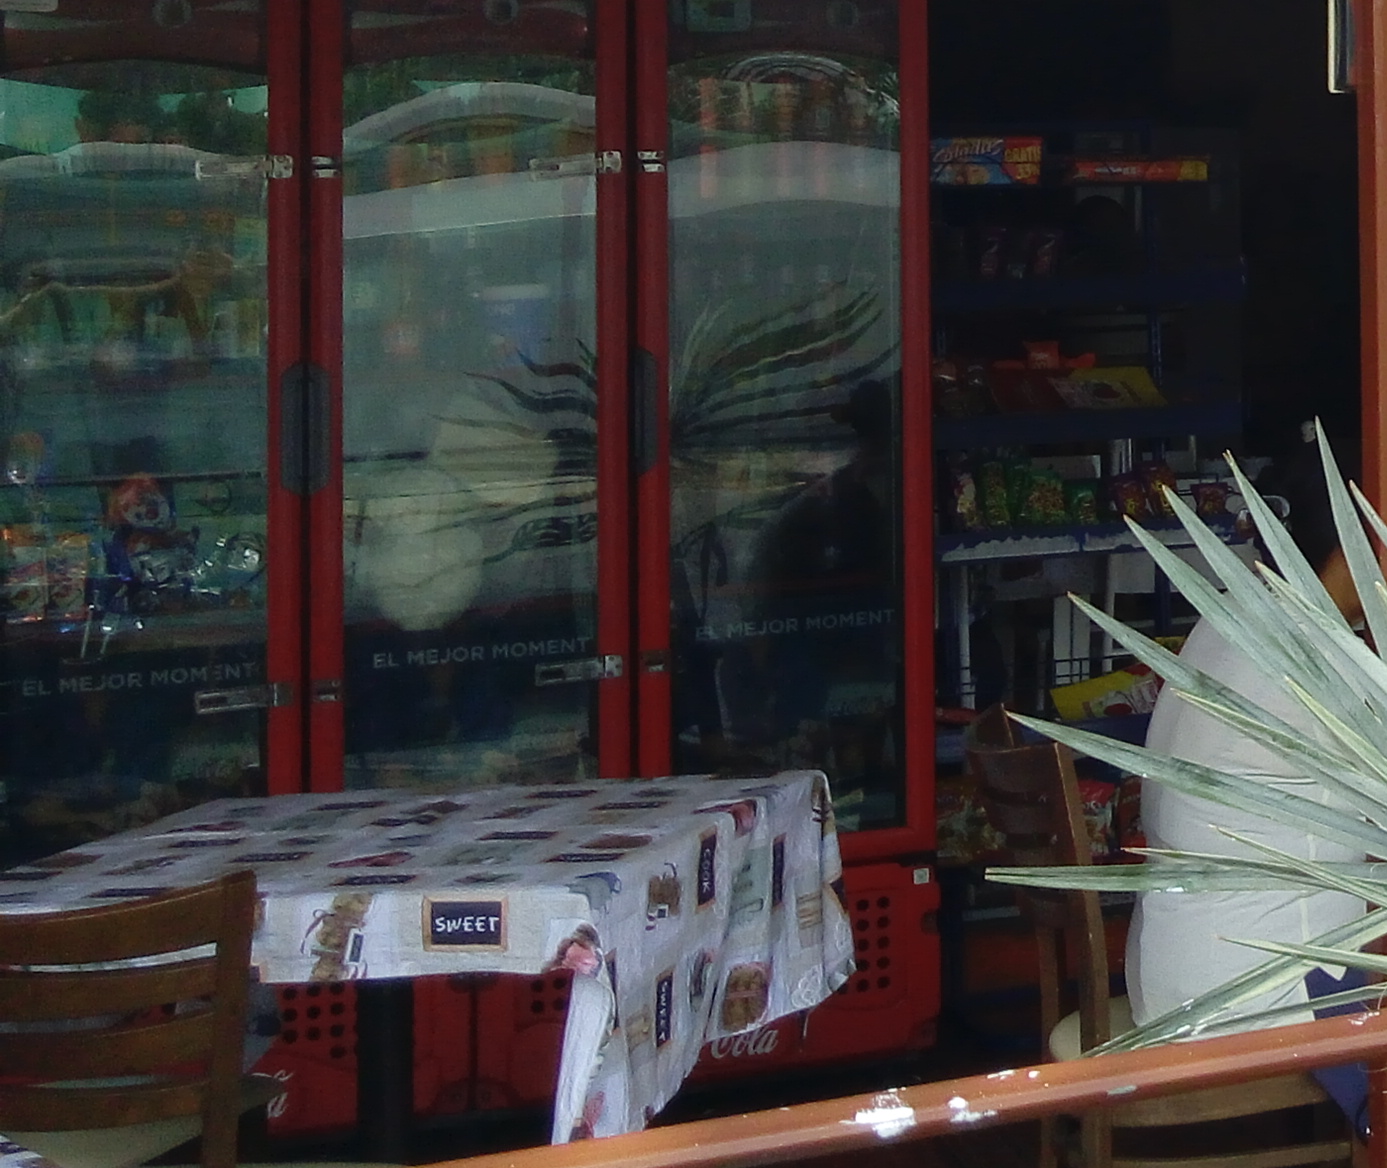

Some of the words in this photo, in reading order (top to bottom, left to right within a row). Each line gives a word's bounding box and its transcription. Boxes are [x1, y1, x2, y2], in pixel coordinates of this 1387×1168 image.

[728, 617, 799, 639] MEJOR
[806, 608, 896, 630] MOMENT
[373, 653, 399, 670] EL
[407, 645, 485, 666] MEJOR
[492, 636, 588, 660] MOMENT
[21, 679, 51, 697] EL
[59, 671, 143, 694] MEJOR
[434, 915, 500, 933] SWEET
